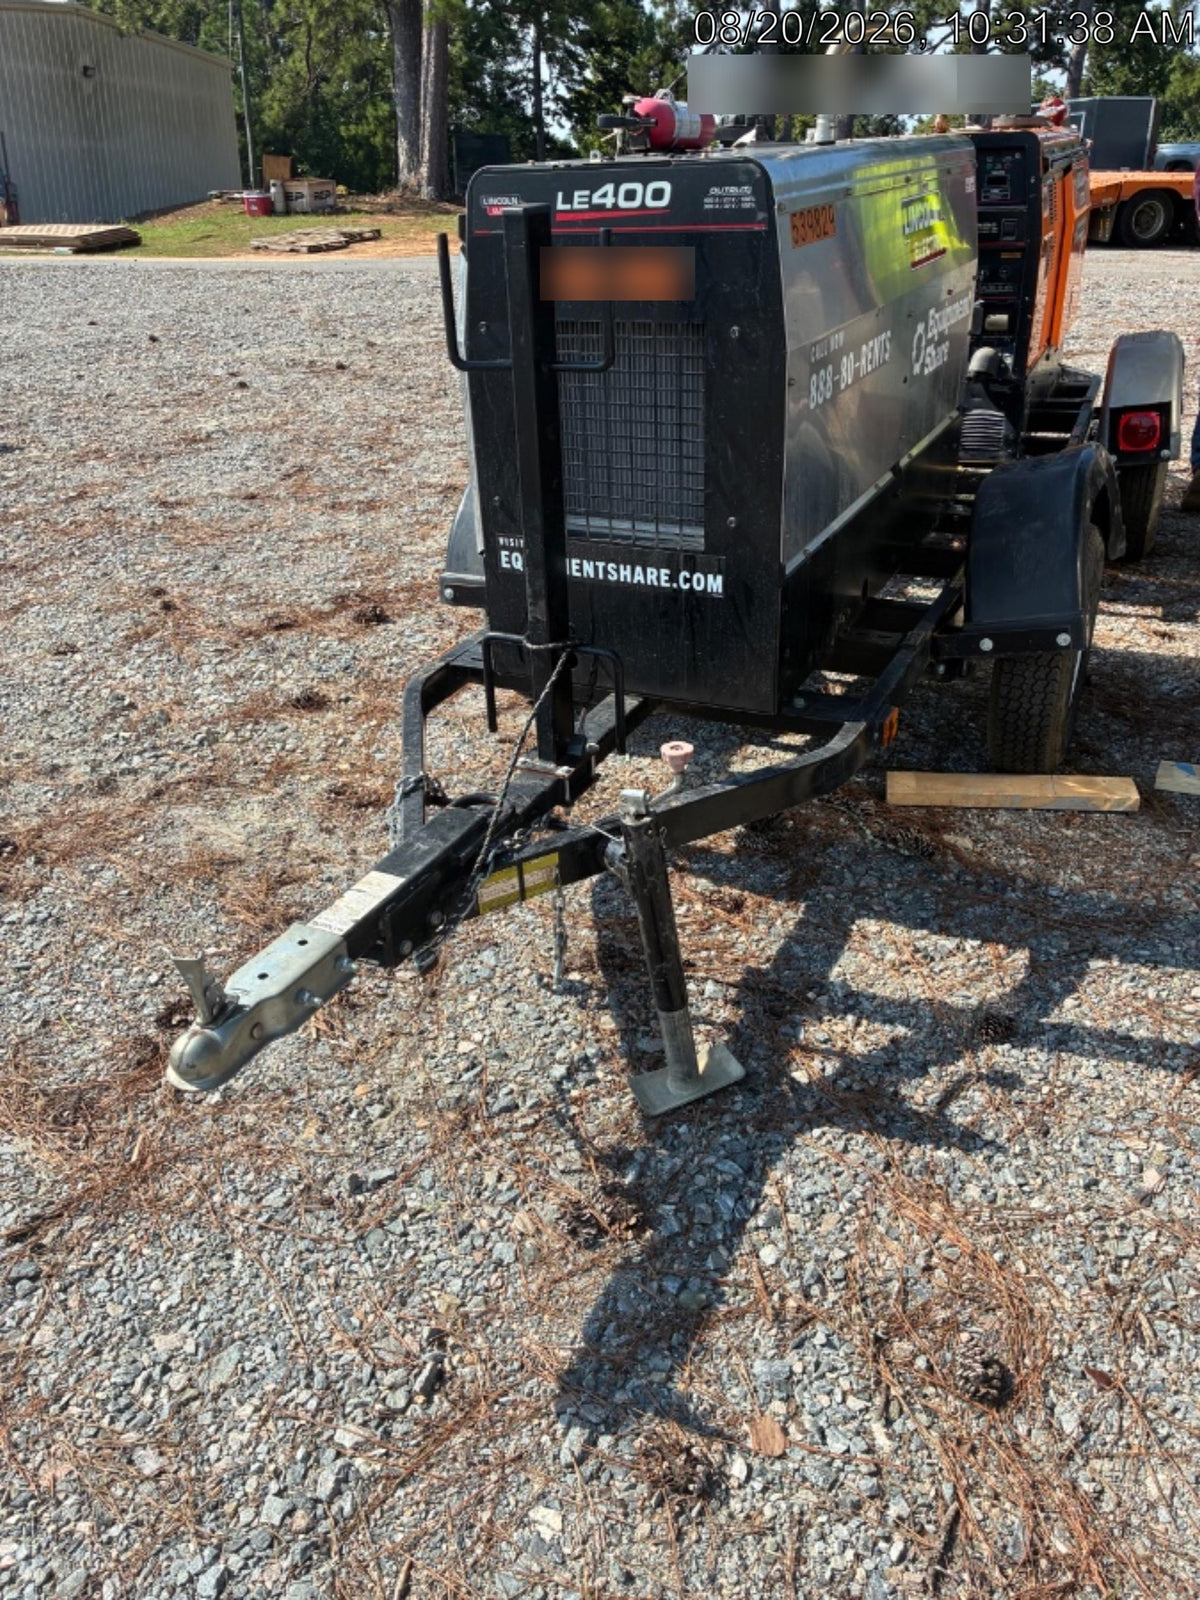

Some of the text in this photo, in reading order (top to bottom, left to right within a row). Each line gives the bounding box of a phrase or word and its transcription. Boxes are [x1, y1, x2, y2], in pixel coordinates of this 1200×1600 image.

[482, 196, 518, 206] LINCOLN
[555, 181, 671, 210] LE400
[809, 329, 892, 410] 888-80-RENTS
[924, 341, 950, 376] Share
[498, 536, 524, 548] VISIT
[500, 550, 723, 593] EQENTSHARE.COM
